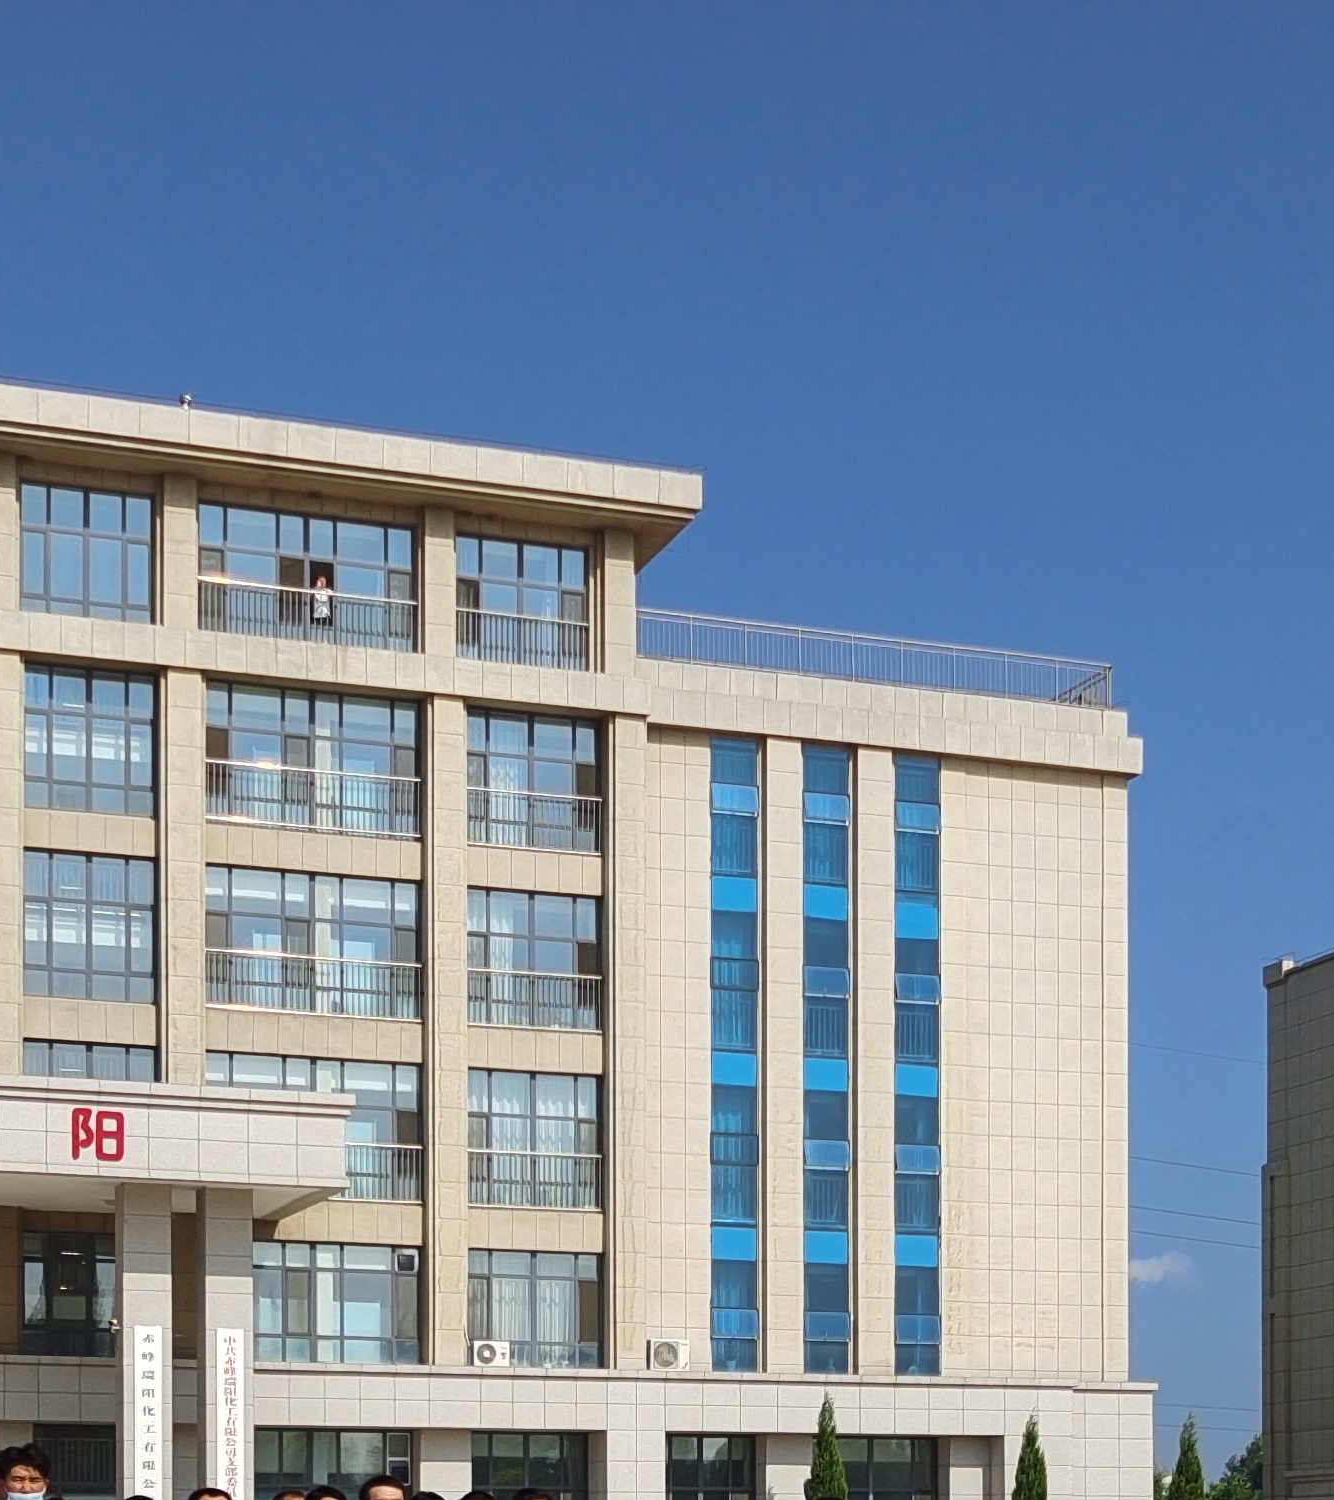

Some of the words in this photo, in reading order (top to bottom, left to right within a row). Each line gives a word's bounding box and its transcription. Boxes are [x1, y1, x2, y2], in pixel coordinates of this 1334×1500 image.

[141, 1333, 157, 1489] 赤峰瑞阳化工有限公
